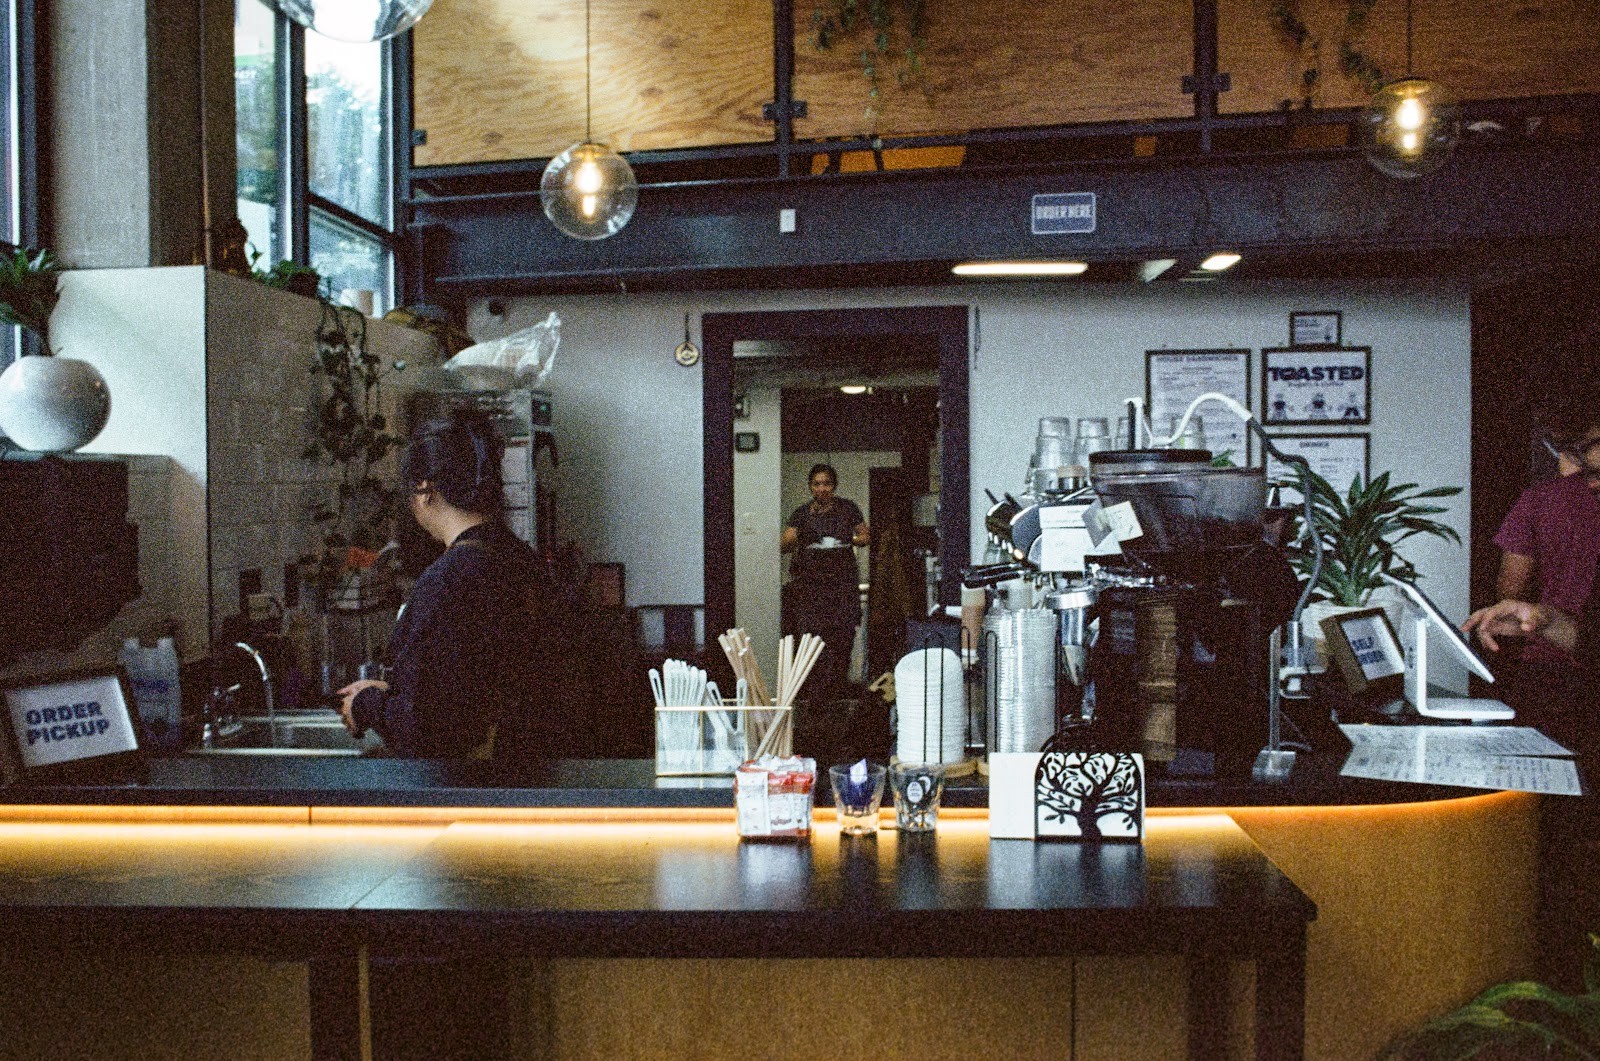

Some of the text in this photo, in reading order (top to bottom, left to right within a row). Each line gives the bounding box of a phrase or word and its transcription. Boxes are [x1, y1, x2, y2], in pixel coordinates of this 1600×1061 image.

[1268, 366, 1365, 381] TOASTED
[26, 701, 102, 726] ORDER
[27, 718, 109, 745] PICKUP
